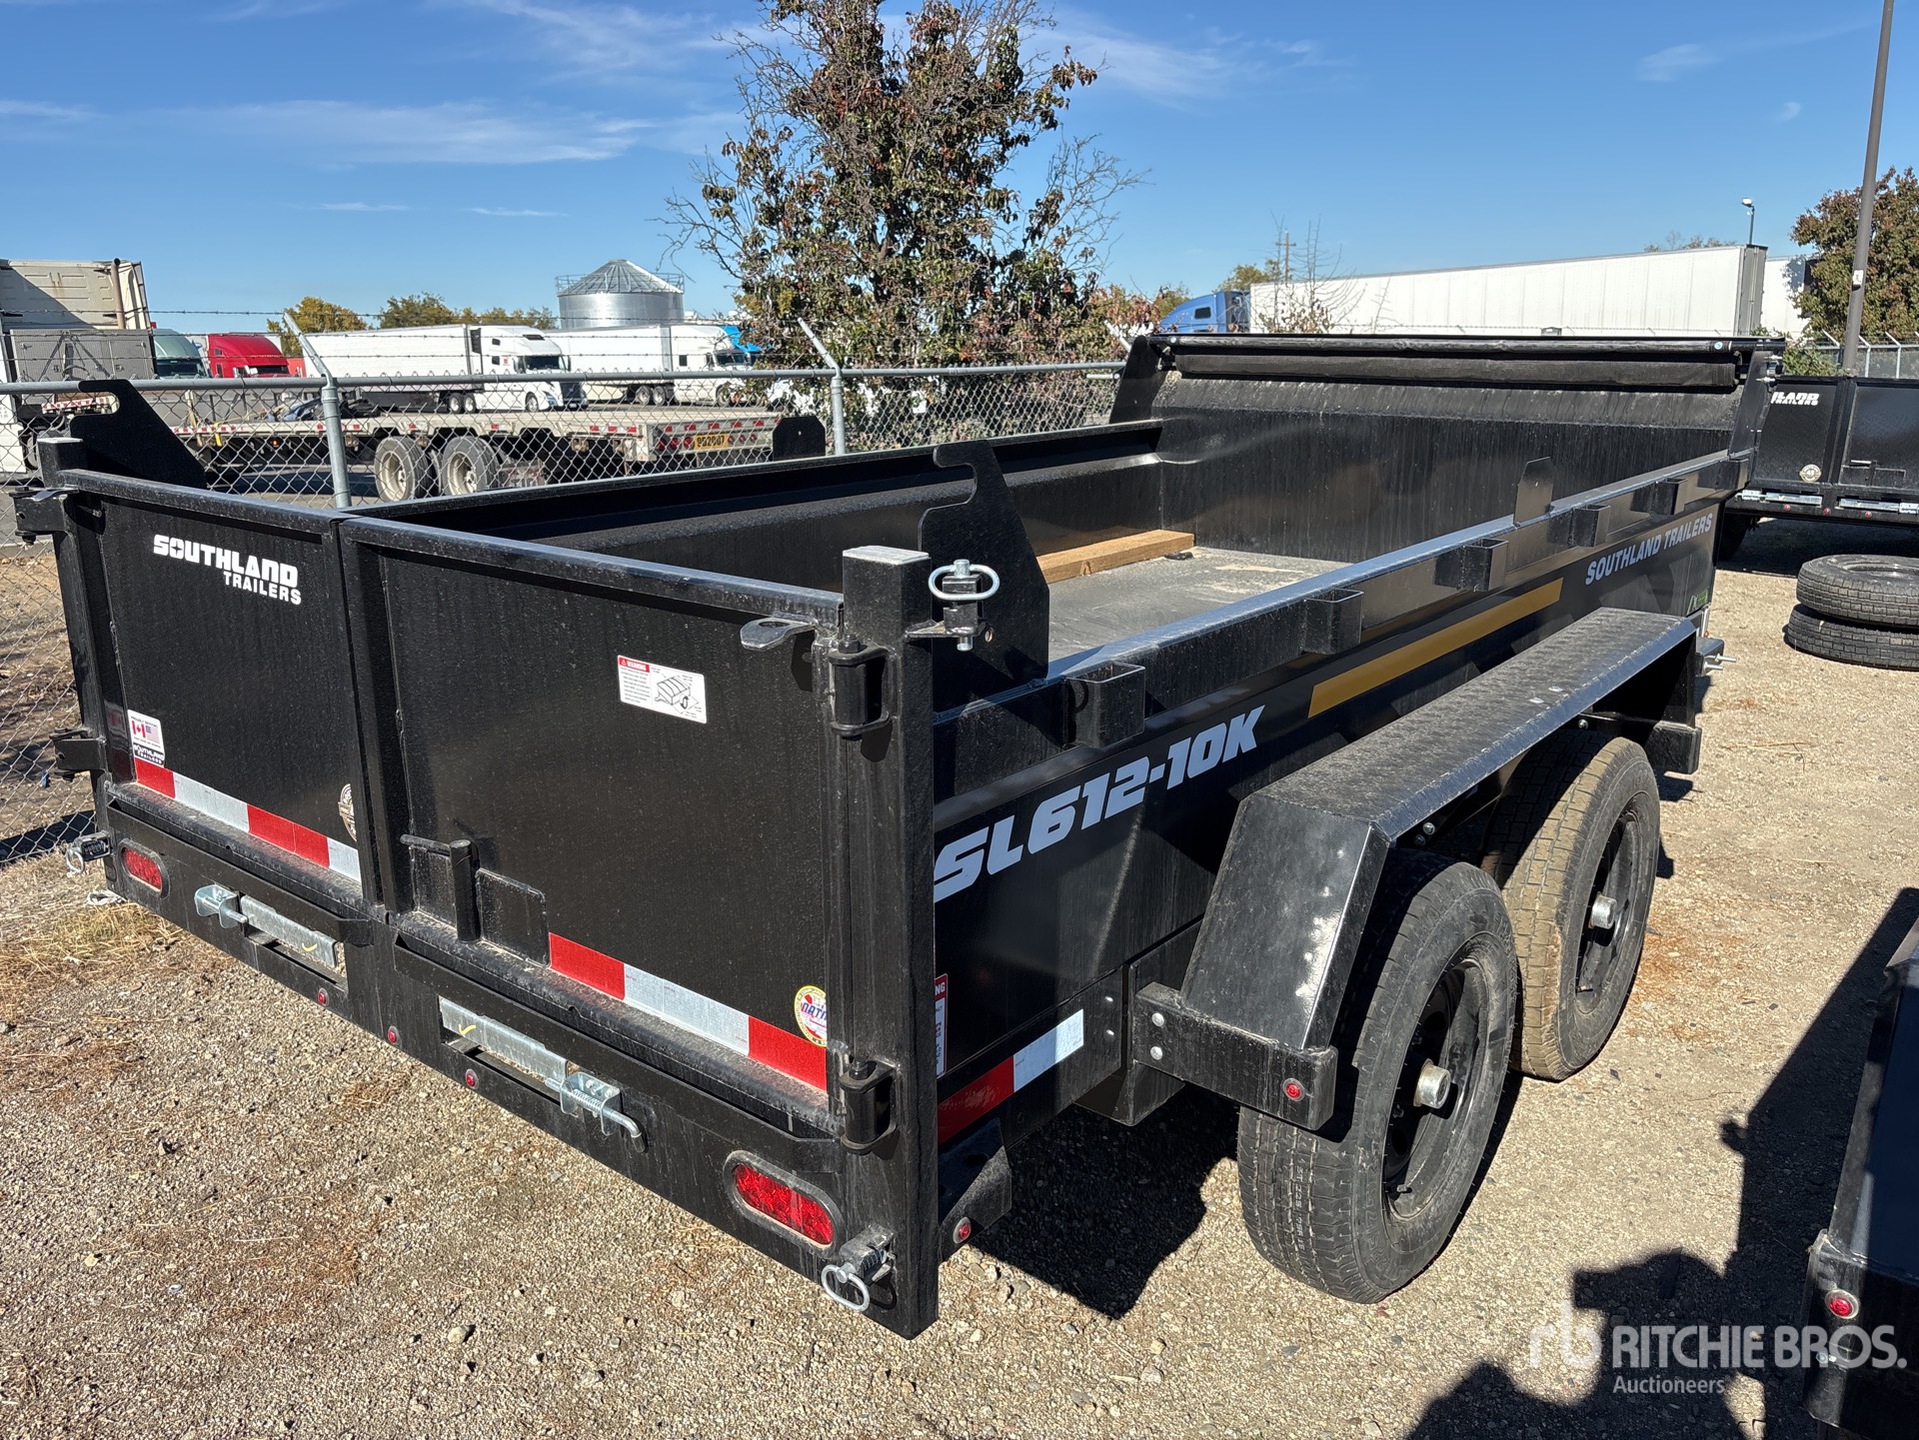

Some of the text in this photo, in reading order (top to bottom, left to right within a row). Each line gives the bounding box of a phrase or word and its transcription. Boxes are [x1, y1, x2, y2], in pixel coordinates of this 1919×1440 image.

[153, 533, 298, 588] SOUTHLAND
[1585, 512, 1713, 586] SOUTHLAND TRAILERS
[223, 570, 301, 605] TRAILERS
[933, 704, 1266, 903] SL612-10K
